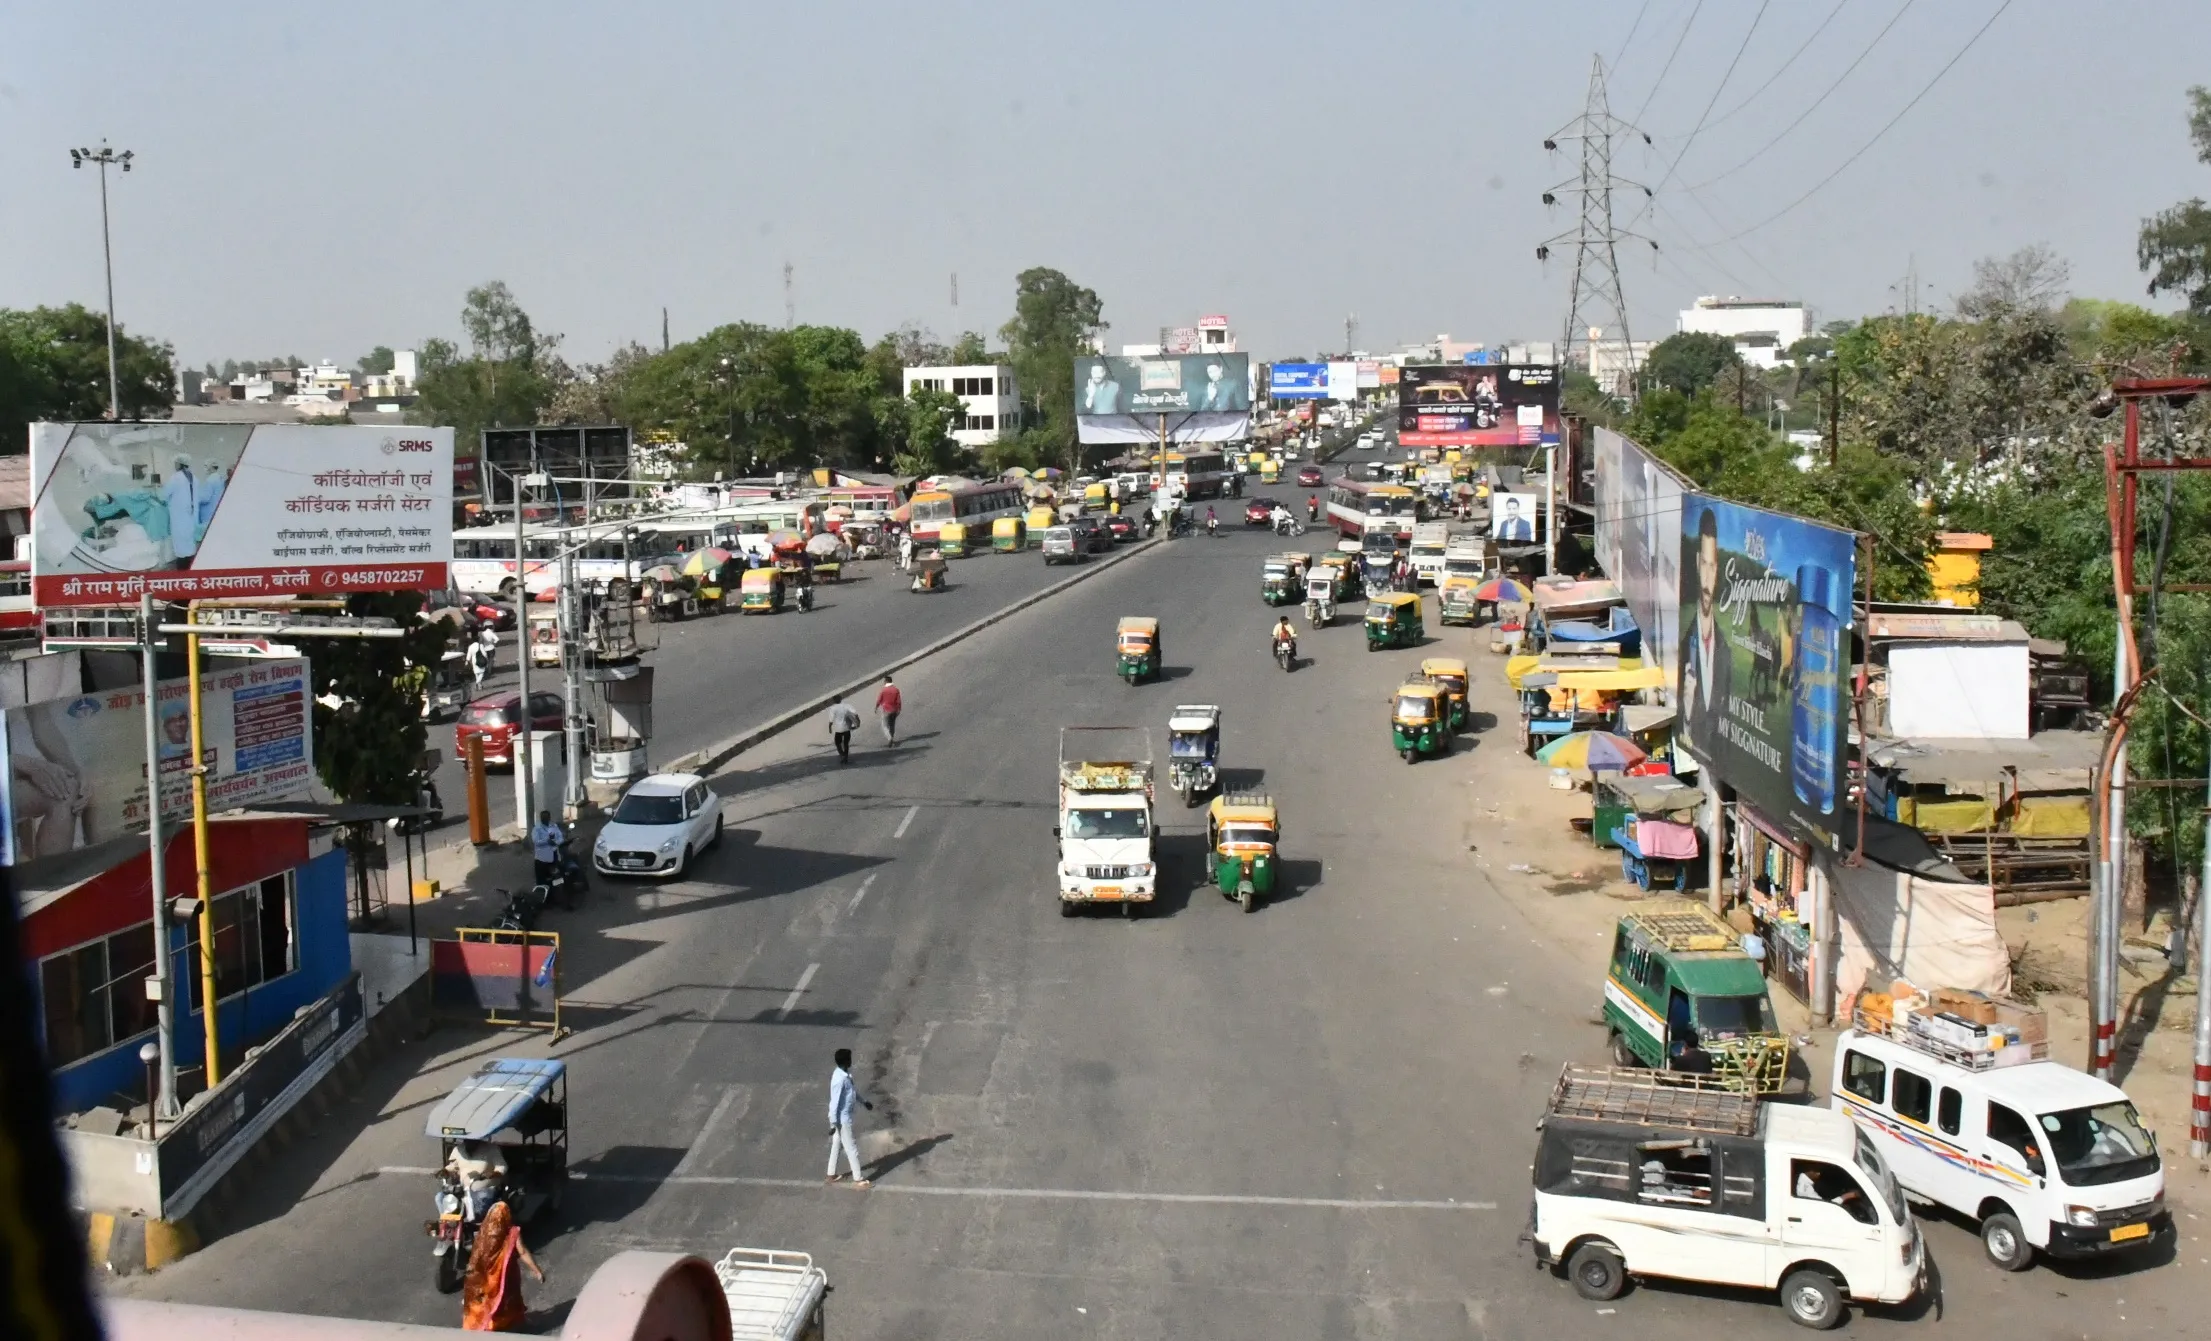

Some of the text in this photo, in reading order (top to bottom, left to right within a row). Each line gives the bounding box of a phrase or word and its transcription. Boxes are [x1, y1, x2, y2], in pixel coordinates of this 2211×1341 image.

[399, 440, 432, 452] SRMS
[312, 470, 432, 490] कॉर्डियोलॉजी एवं
[356, 494, 395, 512] सर्जरी
[400, 494, 432, 512] सेंटर
[62, 577, 82, 595] श्री
[85, 581, 113, 594] राम
[115, 575, 145, 597] मूर्ति
[147, 577, 198, 592] स्मारक
[271, 569, 311, 587] बरेली
[342, 569, 424, 585] 9458702257
[1719, 557, 1789, 625] Siggnature
[1728, 695, 1740, 717] MY
[1718, 717, 1731, 738] MY
[1731, 722, 1782, 773] SIGGNATURE
